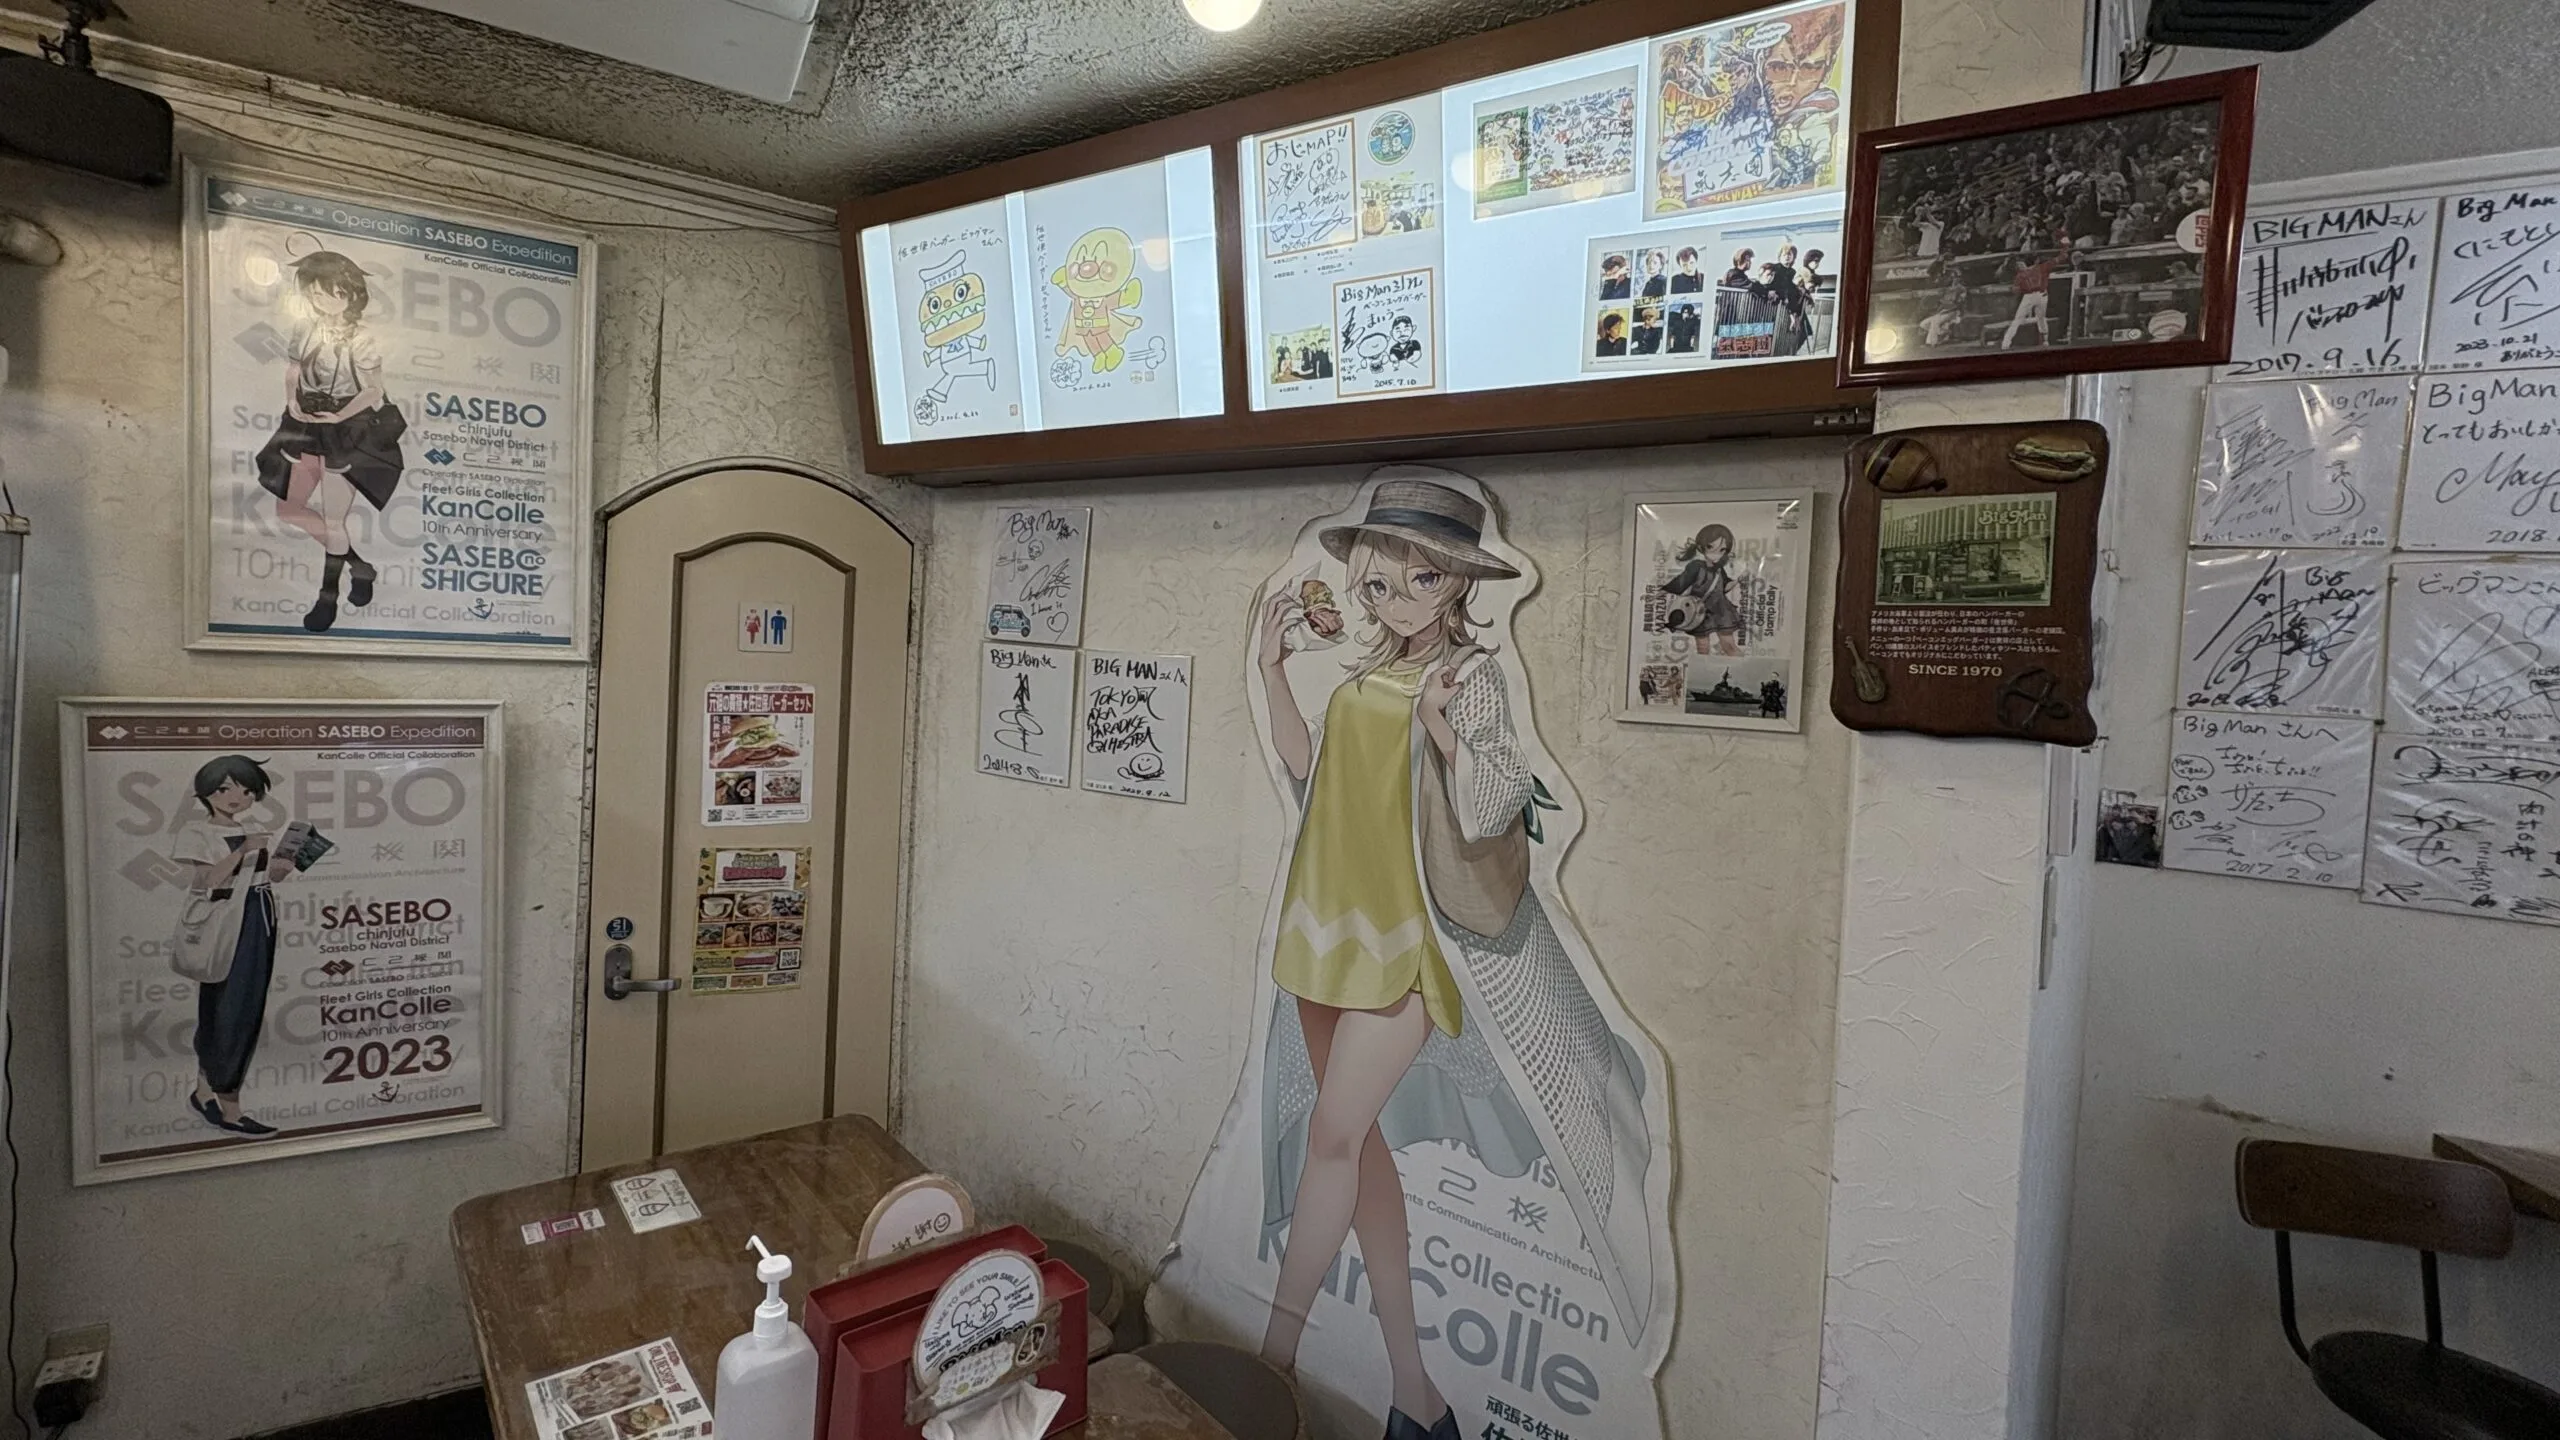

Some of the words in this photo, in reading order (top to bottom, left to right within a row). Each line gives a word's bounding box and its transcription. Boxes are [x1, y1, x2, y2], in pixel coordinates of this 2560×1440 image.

[2457, 196, 2501, 223] Big
[2503, 192, 2560, 211] Man
[2253, 219, 2310, 245] BIG
[2316, 201, 2390, 237] MAN
[332, 208, 421, 238] Operation
[425, 226, 488, 250] SASEBO
[491, 239, 572, 268] Expedition
[424, 252, 469, 269] KanColle
[471, 260, 506, 276] Official
[508, 266, 572, 287] Collaboration
[1341, 287, 1364, 303] Big
[1365, 284, 1392, 300] Man
[2353, 386, 2400, 408] Man
[2428, 382, 2487, 415] Big
[2488, 377, 2557, 400] Man
[425, 391, 547, 428] SASEBO
[423, 430, 467, 444] Sasebo
[470, 436, 505, 448] Naval
[507, 439, 545, 452] District
[458, 423, 513, 438] chinjufu
[422, 482, 452, 495] Fleet
[455, 486, 481, 498] Girls
[484, 488, 545, 503] Collection
[422, 494, 545, 524] KanColle
[422, 519, 450, 534] 10th
[453, 523, 543, 543] Anniversary
[1007, 511, 1036, 544] Big
[1037, 509, 1068, 533] Man
[2484, 528, 2546, 545] 2018
[420, 567, 543, 596] SHIGURE
[2305, 566, 2351, 587] Big
[1764, 584, 1779, 607] Rally
[1755, 593, 1766, 627] Official
[1764, 607, 1777, 638] Stamp
[990, 648, 1015, 669] Big
[1092, 656, 1122, 677] BIG
[1126, 660, 1159, 682] MAN
[1908, 663, 1958, 676] SINCE
[1962, 665, 2003, 678] 1970
[218, 723, 312, 742] Operation
[317, 724, 386, 738] SASEBO
[390, 723, 477, 742] Expedition
[1088, 714, 1148, 741] PARADISE
[2183, 714, 2218, 738] Big
[2223, 718, 2267, 735] Man
[2278, 720, 2340, 742] さんへ
[316, 751, 365, 761] KanColle
[368, 750, 405, 760] Official
[407, 749, 476, 760] Collaboration
[320, 898, 452, 930] SASEBO
[319, 943, 367, 954] Sasebo
[370, 939, 407, 950] Naval
[410, 935, 450, 947] District
[356, 926, 415, 941] chinjufu
[320, 992, 353, 1006] Fleet
[355, 989, 383, 1001] Girls
[386, 983, 452, 998] Collection
[320, 996, 452, 1026] KanColle
[354, 1017, 452, 1040] Anniversary
[322, 1034, 453, 1084] 2023
[1427, 1199, 1528, 1250] Communication
[1530, 1243, 1603, 1282] Architectu
[960, 1281, 975, 1297] SEE
[976, 1272, 999, 1285] YOUR
[1424, 1234, 1609, 1344] Collection
